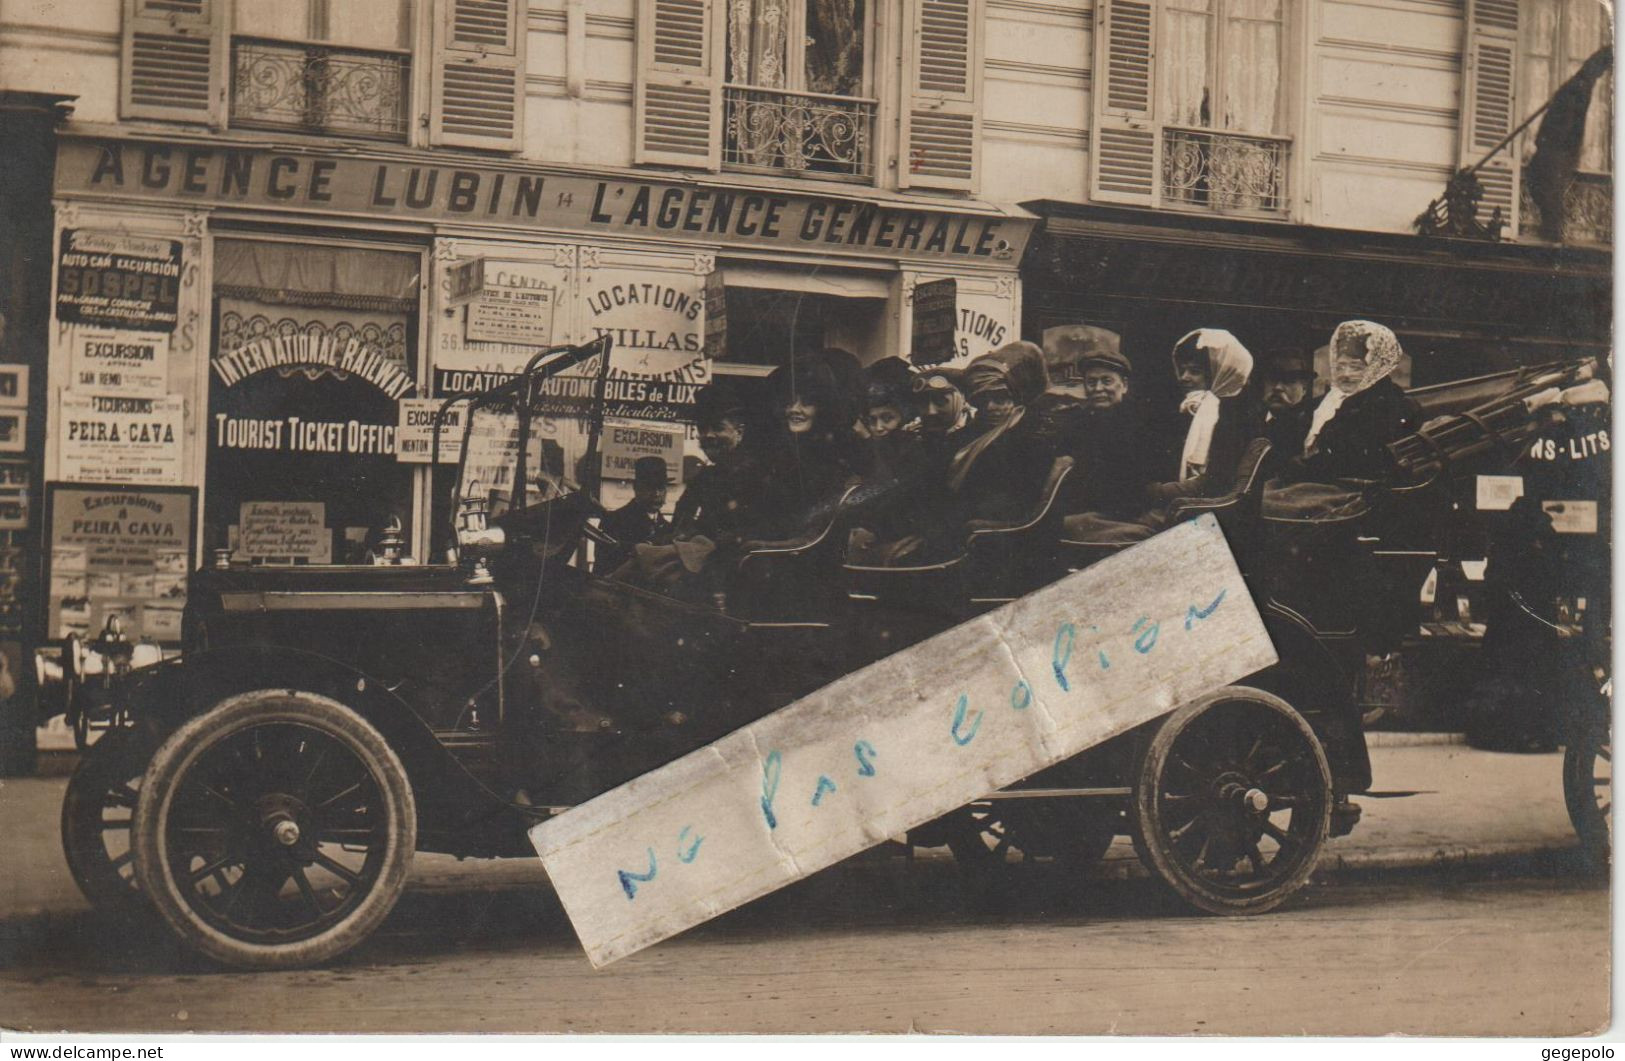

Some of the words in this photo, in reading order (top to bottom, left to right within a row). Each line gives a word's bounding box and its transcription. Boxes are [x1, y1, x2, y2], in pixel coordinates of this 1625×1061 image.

[91, 146, 337, 201] AGENCE
[371, 166, 545, 217] LUBIN
[557, 192, 574, 208] 14
[590, 182, 788, 238] L'AGENCE
[62, 254, 85, 267] AUTO
[116, 258, 179, 277] EXCURSION
[62, 270, 174, 303] SOSPEL
[587, 283, 702, 320] LOCATIONS
[592, 326, 700, 352] VILLAS
[84, 341, 154, 360] EXCURSION
[211, 334, 339, 387] INTERNATIONAL
[340, 337, 414, 400] RAILWAY
[99, 373, 121, 386] REMO
[649, 387, 663, 402] de
[667, 384, 704, 404] LUX
[407, 410, 460, 426] EXCURON
[402, 439, 428, 452] MENTON
[614, 429, 673, 448] EXCURSION
[83, 494, 163, 513] Excursions
[72, 520, 121, 534] PEIRA
[128, 522, 174, 536] CAVA
